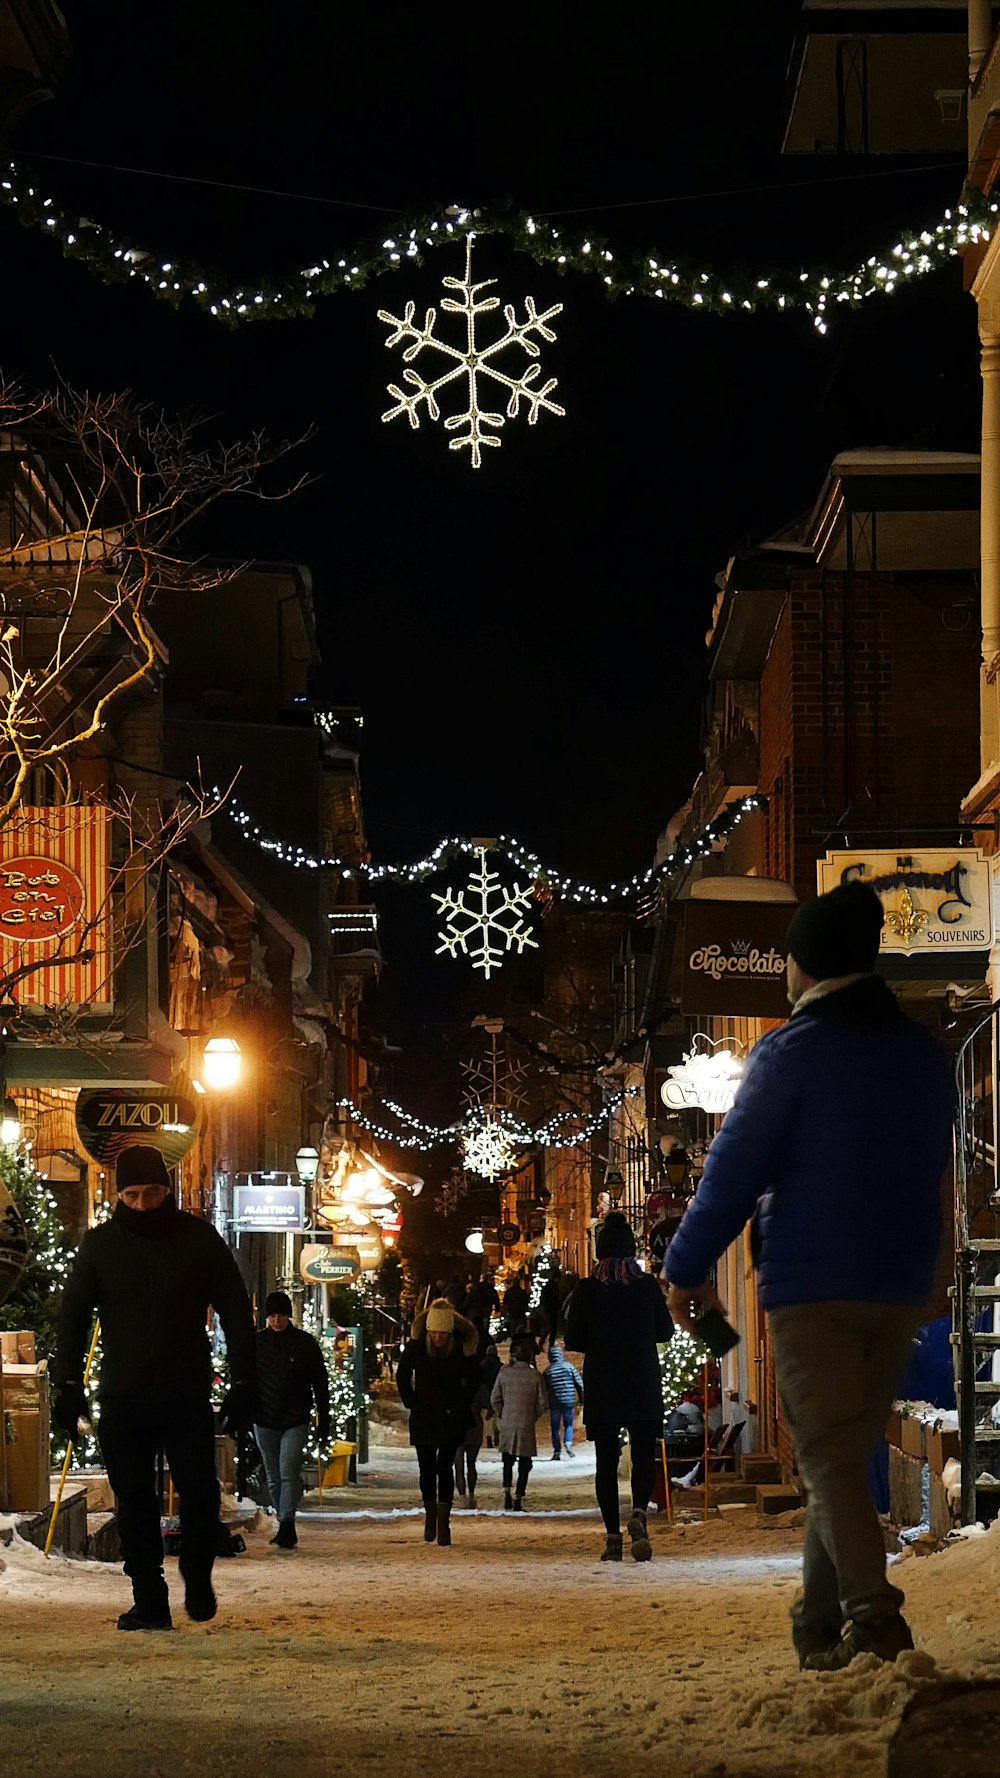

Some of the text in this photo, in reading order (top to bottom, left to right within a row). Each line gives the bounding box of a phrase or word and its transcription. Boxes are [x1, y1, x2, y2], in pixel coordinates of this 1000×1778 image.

[13, 891, 57, 902] en
[1, 905, 66, 923] Ciel
[927, 930, 985, 943] SOUVENIRS
[689, 944, 787, 981] Chocolato
[97, 1102, 179, 1127] ZAZOU
[244, 1205, 296, 1215] MARTINO
